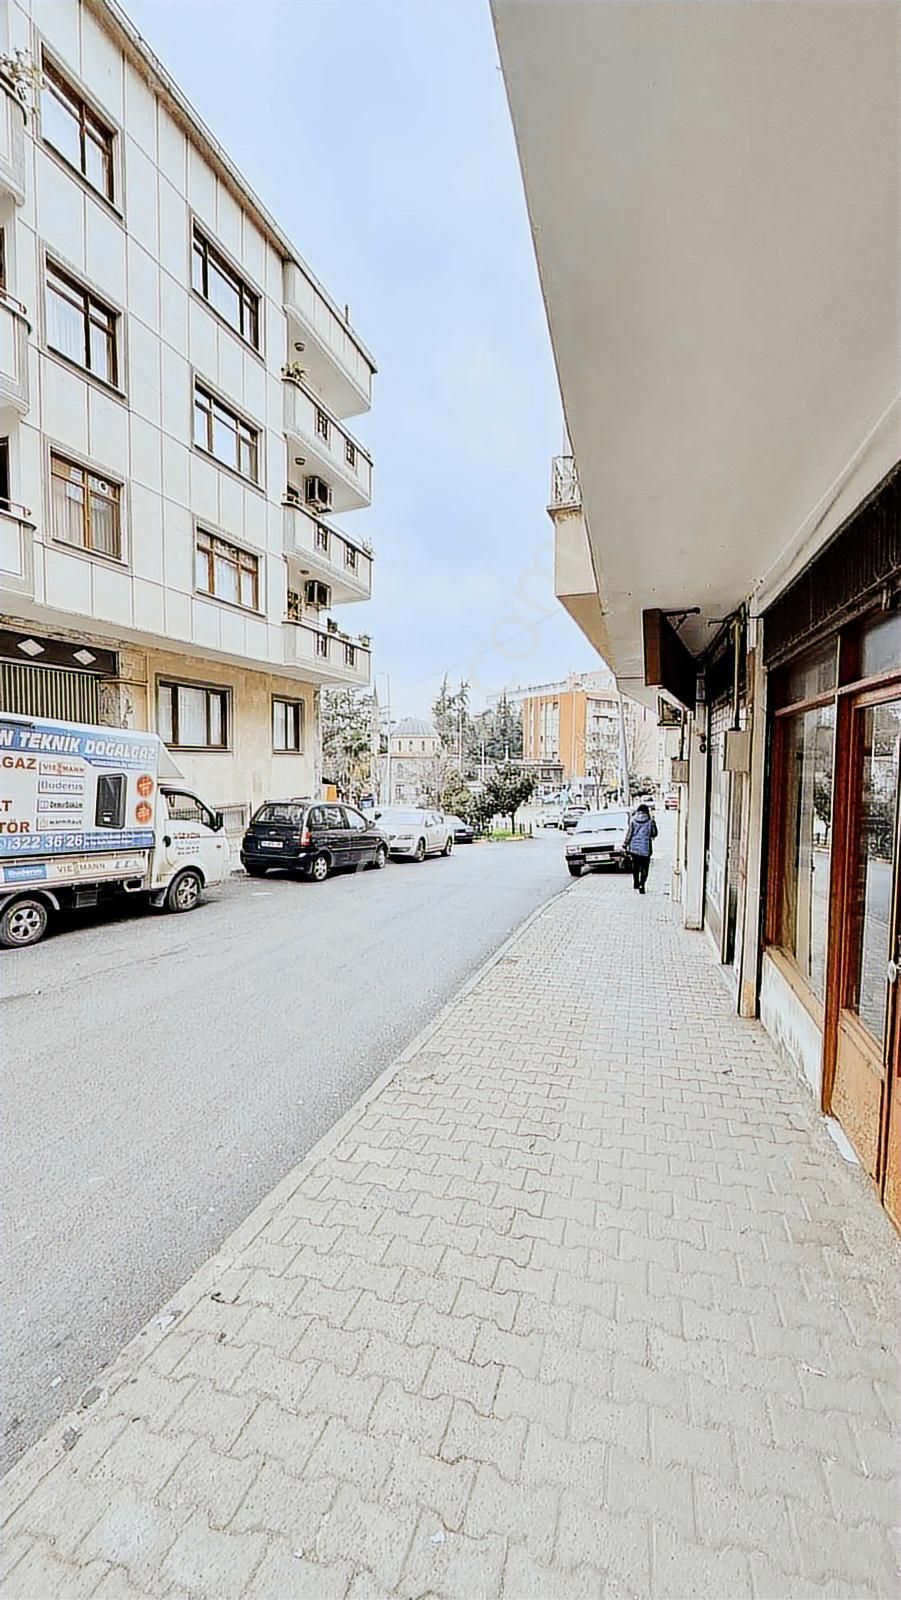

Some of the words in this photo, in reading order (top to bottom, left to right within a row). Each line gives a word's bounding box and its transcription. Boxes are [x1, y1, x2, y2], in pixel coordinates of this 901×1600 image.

[18, 731, 81, 753] TEKNİK
[84, 739, 155, 760] DOĞALGAZ
[0, 756, 37, 770] GAZ
[41, 779, 84, 791] Buderus
[12, 836, 41, 851] 322
[45, 834, 63, 849] 36
[65, 834, 84, 848] 26
